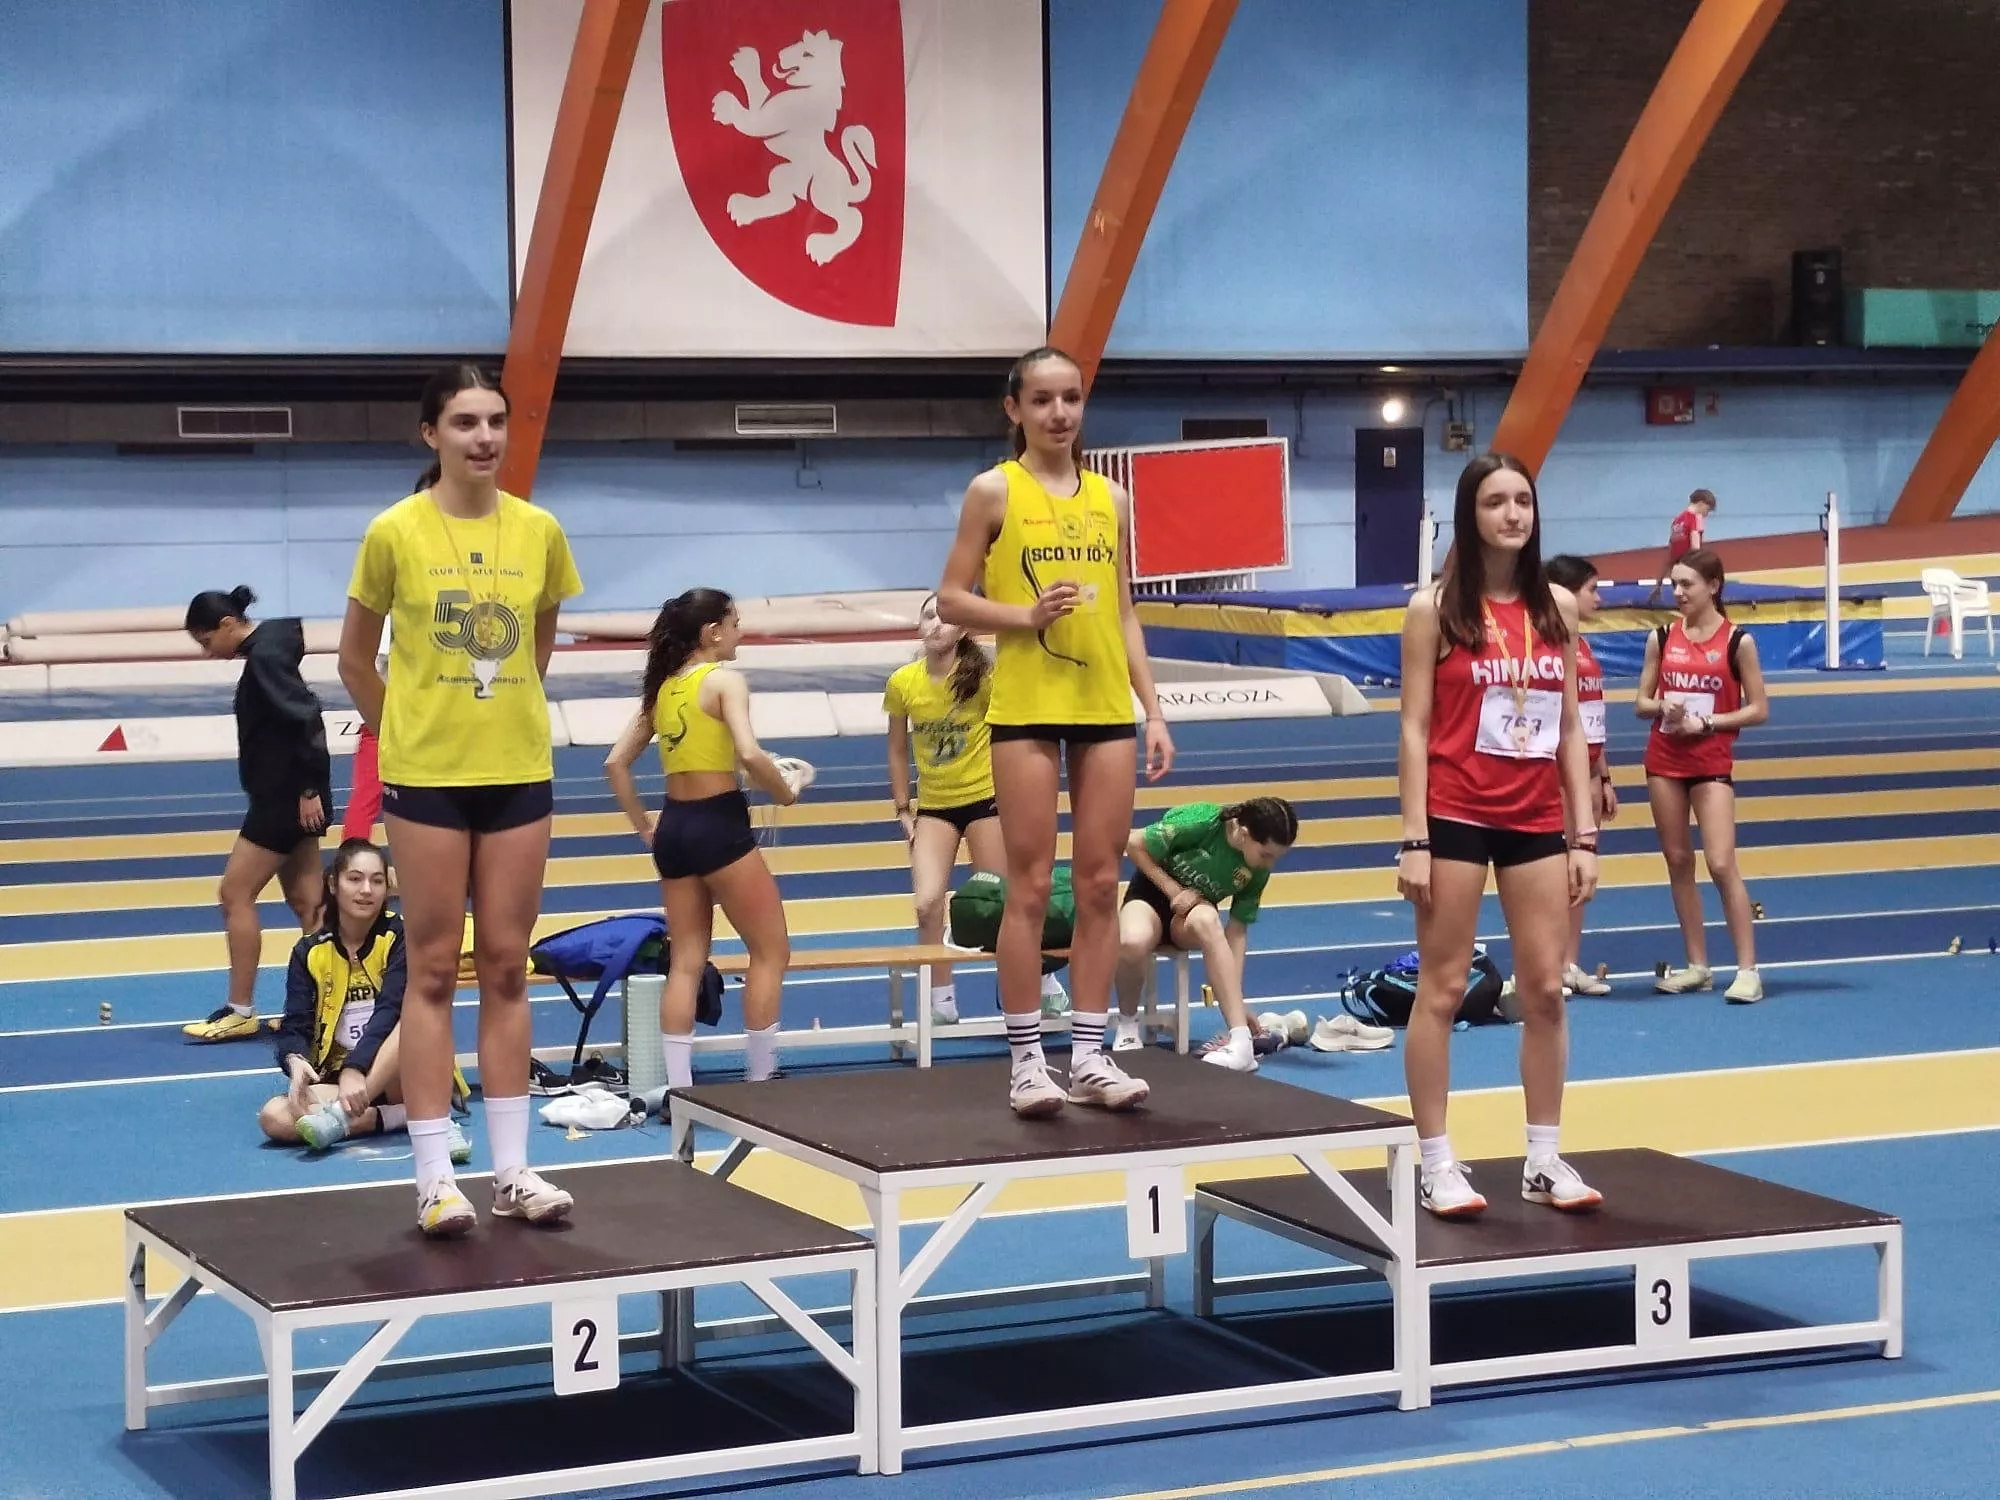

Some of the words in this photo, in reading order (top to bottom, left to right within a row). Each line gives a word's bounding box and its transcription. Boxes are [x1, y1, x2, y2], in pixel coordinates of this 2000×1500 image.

[472, 567, 524, 578] ATLEISMO
[434, 589, 519, 660] 50
[1156, 687, 1282, 706] ARAGOZA
[1148, 1185, 1160, 1234] 1
[1651, 1280, 1672, 1325] 3
[573, 1319, 599, 1372] 2
